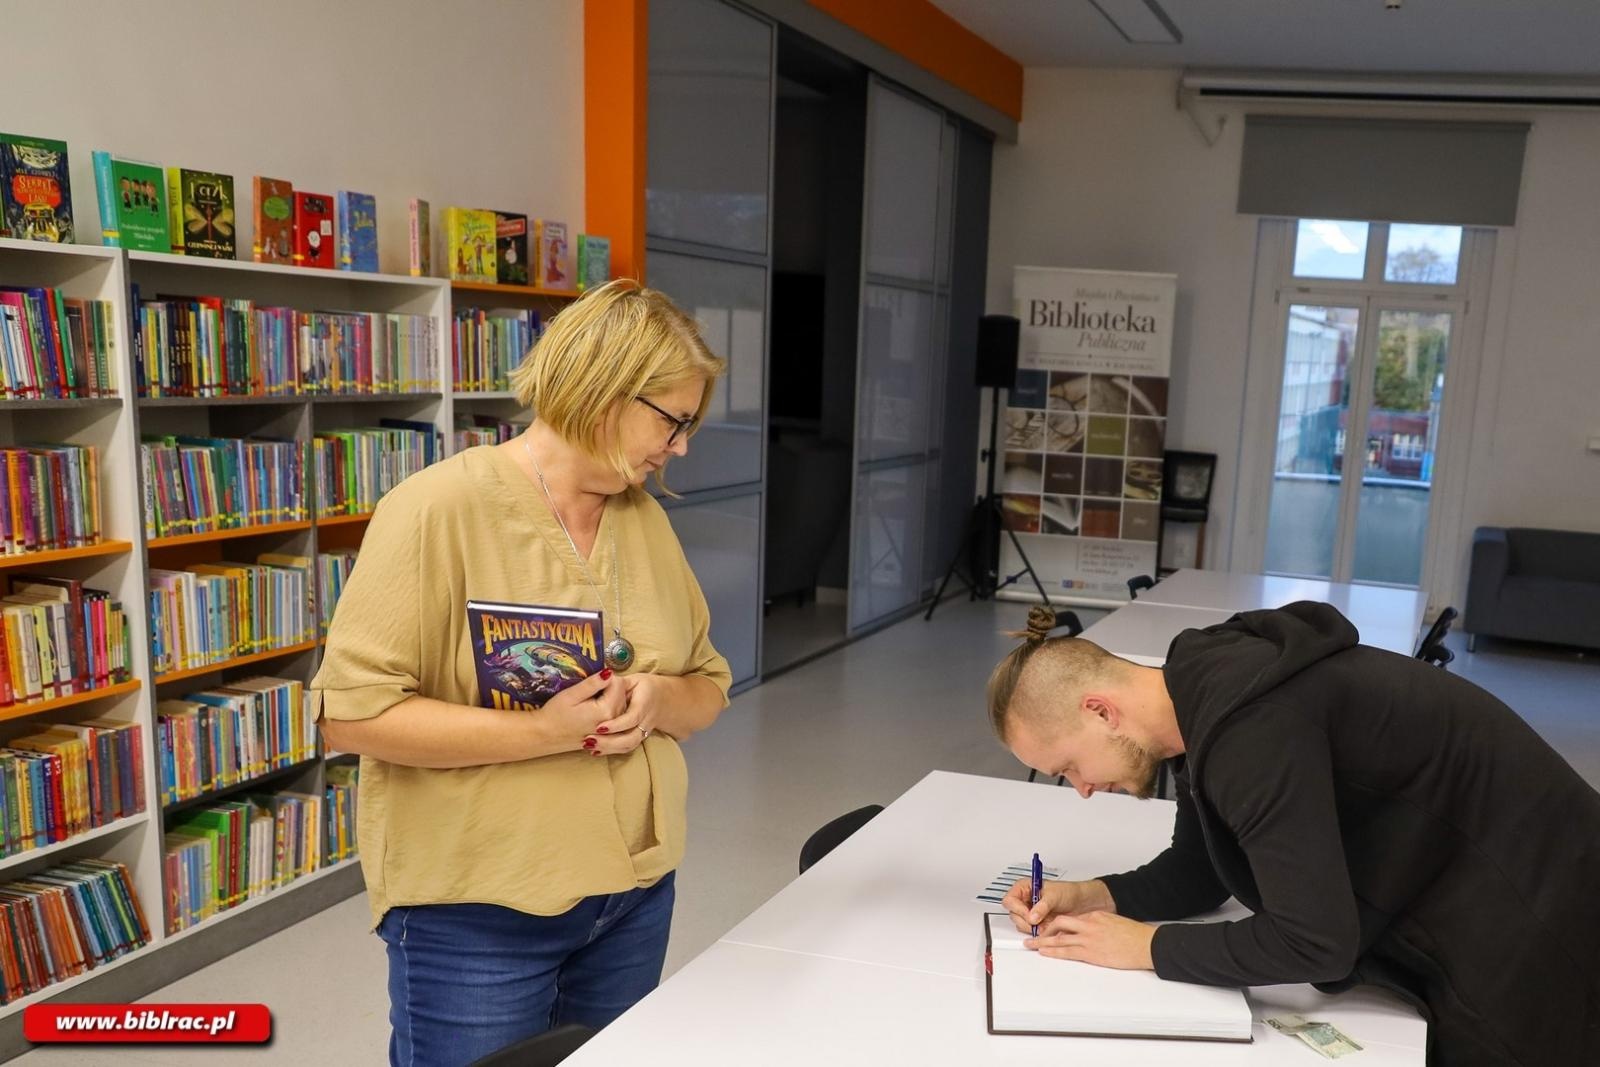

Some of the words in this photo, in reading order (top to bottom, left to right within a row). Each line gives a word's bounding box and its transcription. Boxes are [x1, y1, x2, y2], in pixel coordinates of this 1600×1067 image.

[1029, 300, 1156, 333] Biblioteka
[1077, 331, 1147, 353] Publiczna
[481, 614, 597, 661] FANTASTYCZNA
